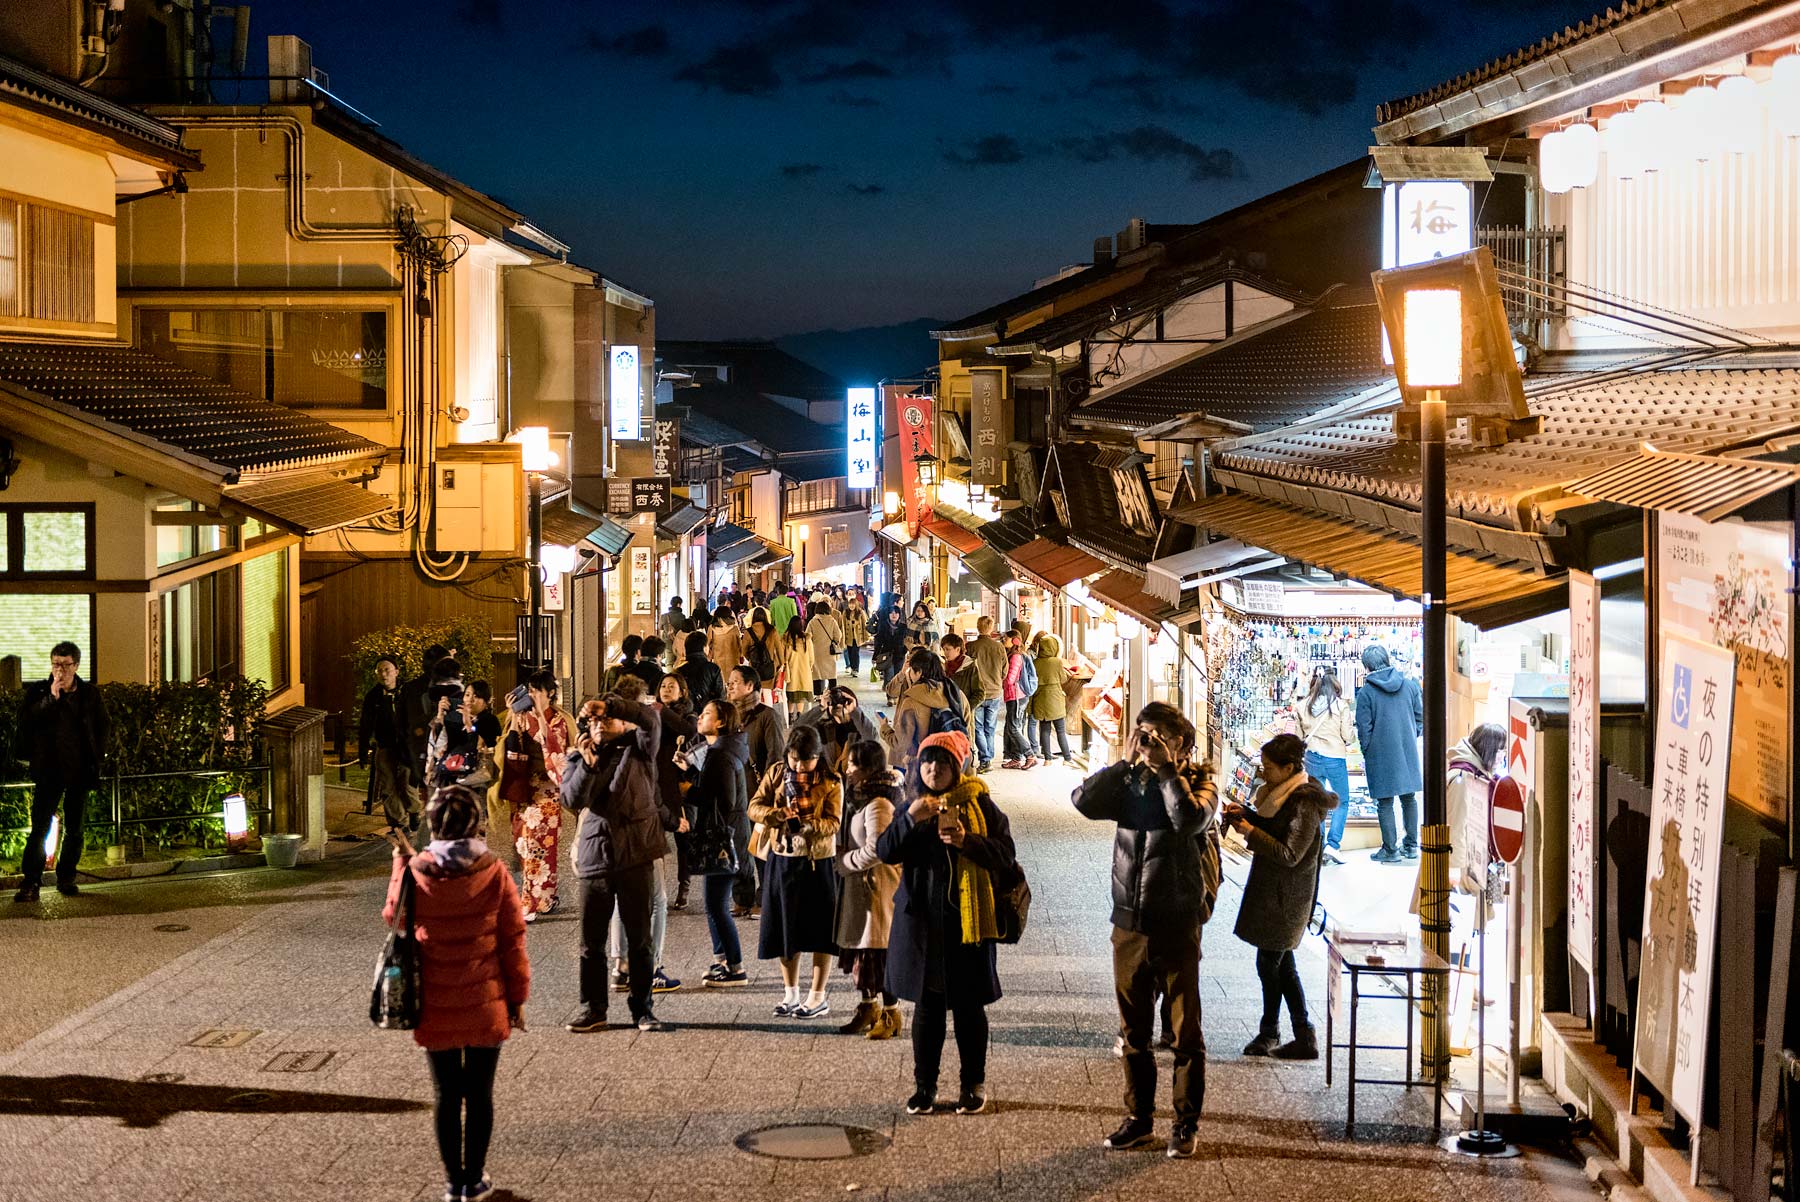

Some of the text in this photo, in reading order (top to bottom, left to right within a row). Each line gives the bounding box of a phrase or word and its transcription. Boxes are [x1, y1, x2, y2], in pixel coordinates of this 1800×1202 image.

[1409, 199, 1459, 258] 梅
[852, 402, 872, 475] 梅山堂
[977, 428, 997, 476] 西利
[635, 483, 664, 491] 有限会社
[635, 493, 665, 507] 西秀
[1576, 623, 1585, 904] Uターンのみ
[1677, 676, 1718, 1073] 夜の特別拝観本部
